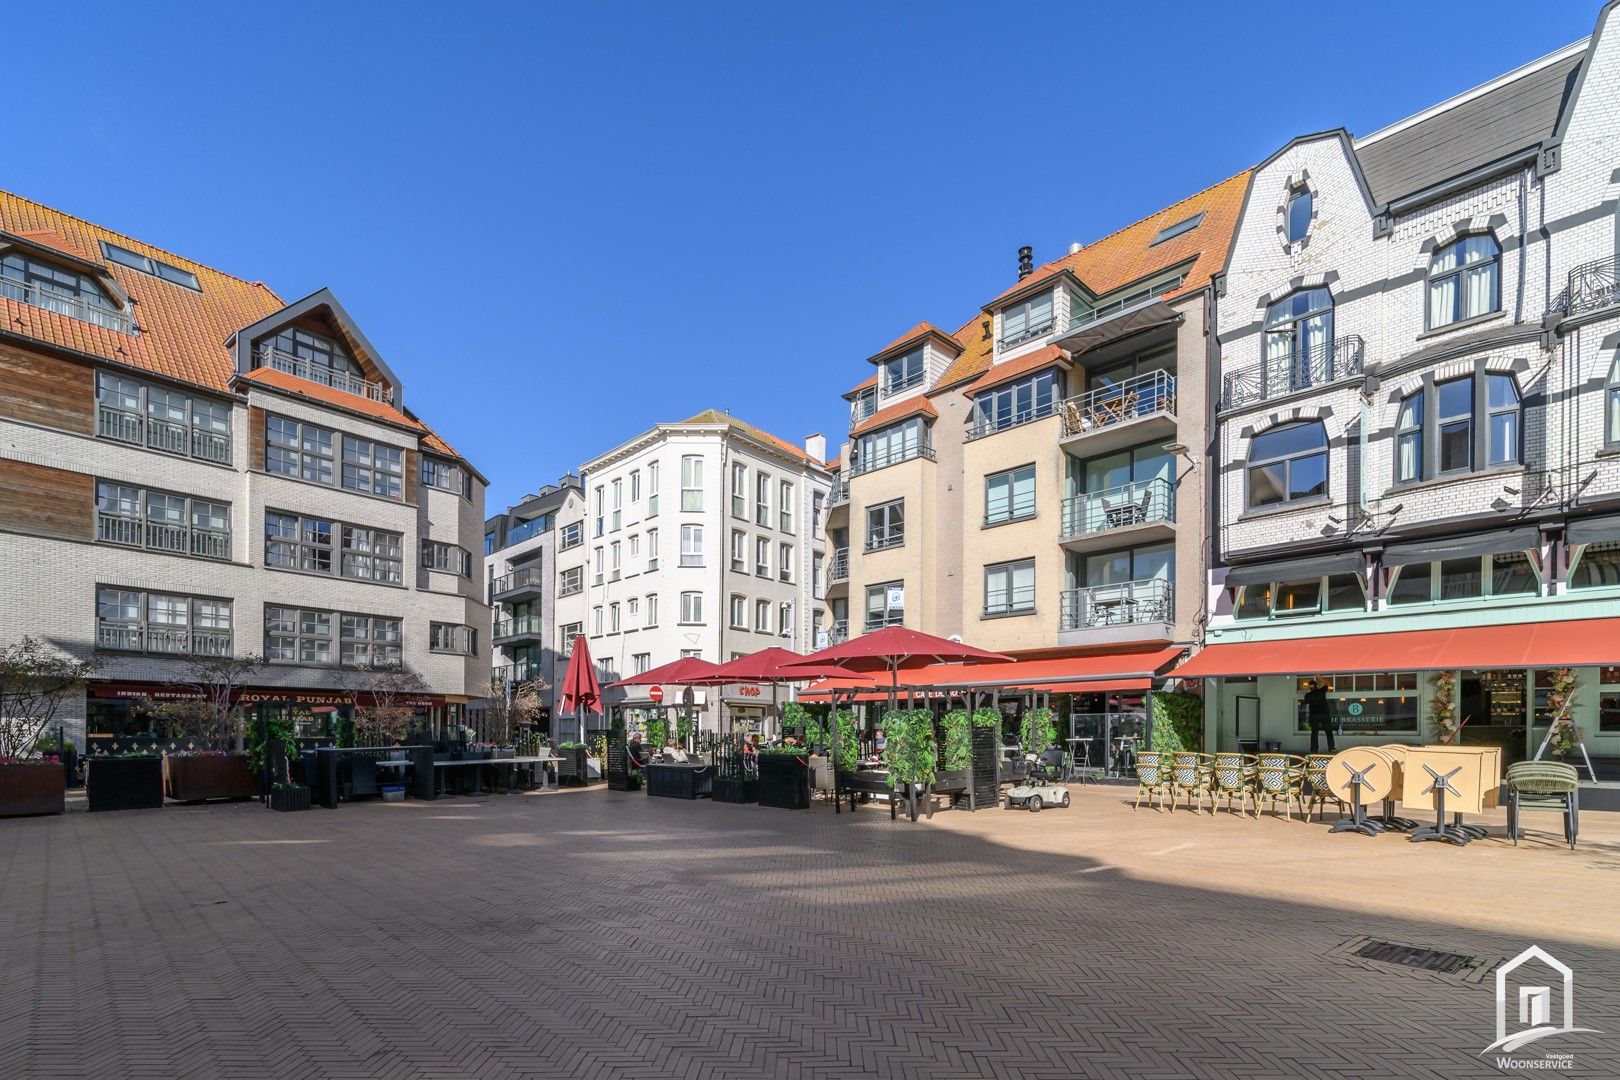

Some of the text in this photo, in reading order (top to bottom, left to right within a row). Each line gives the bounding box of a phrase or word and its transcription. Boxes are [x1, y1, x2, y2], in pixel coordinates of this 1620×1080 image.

[240, 694, 352, 704] ROYAL PUNJAB
[915, 690, 933, 698] CAE
[1351, 704, 1360, 714] B
